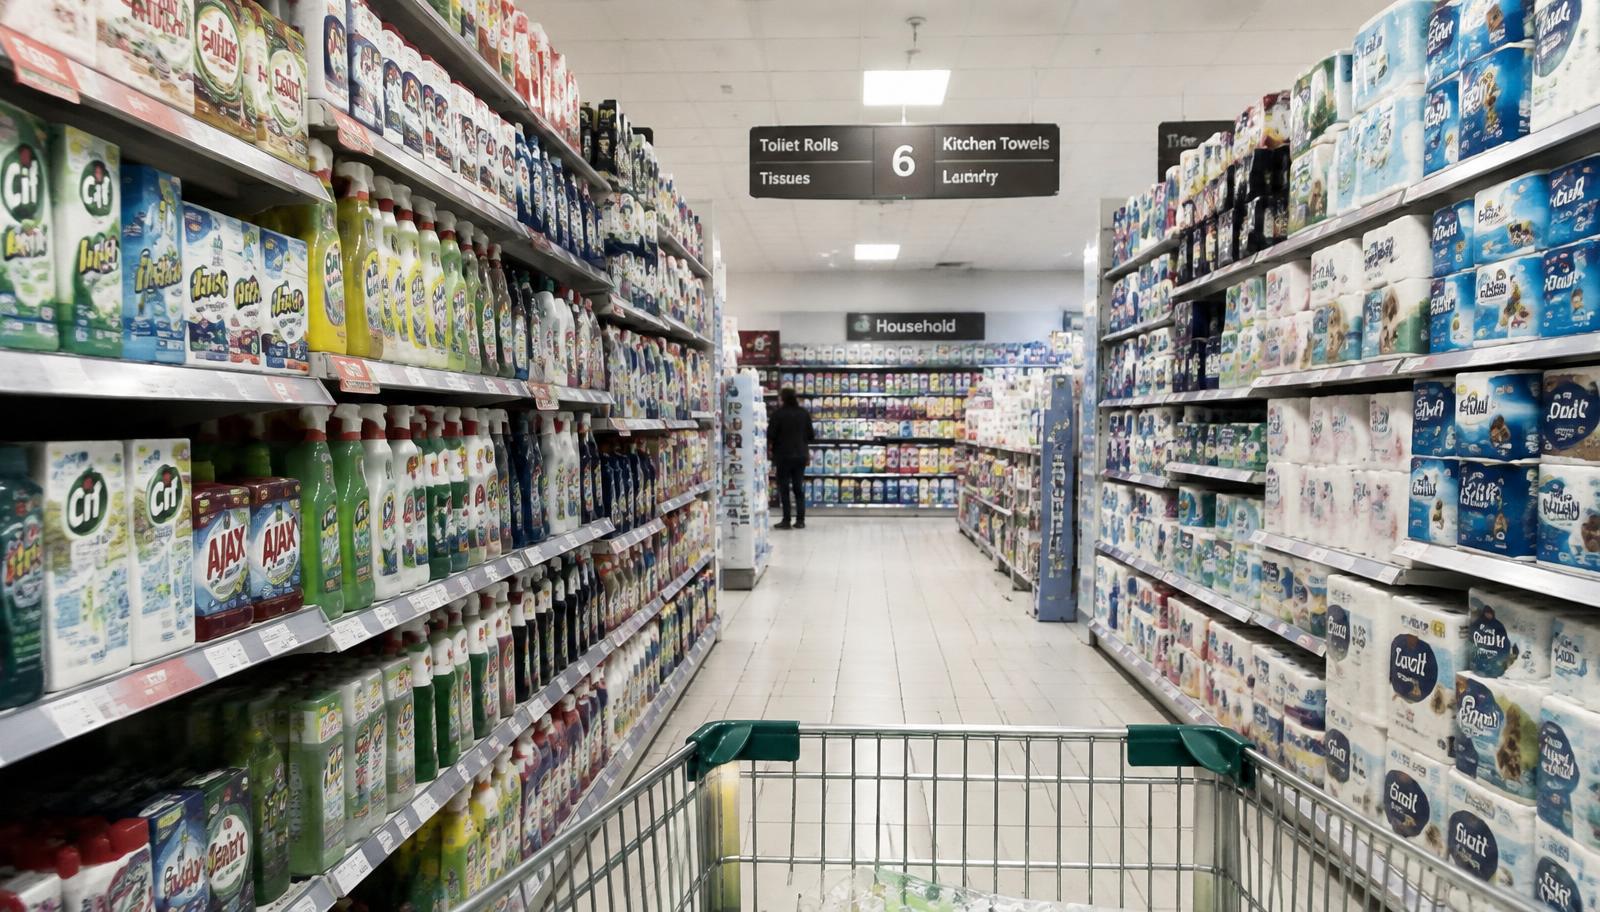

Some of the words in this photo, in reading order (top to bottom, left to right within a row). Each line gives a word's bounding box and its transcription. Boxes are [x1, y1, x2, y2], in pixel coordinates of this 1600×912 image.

[804, 137, 839, 152] Rolls
[943, 136, 996, 151] Kitchen
[999, 136, 1050, 151] Towels
[892, 144, 916, 177] 6
[759, 171, 811, 185] Tissues
[206, 524, 246, 581] AJAX
[262, 515, 297, 568] AJAX
